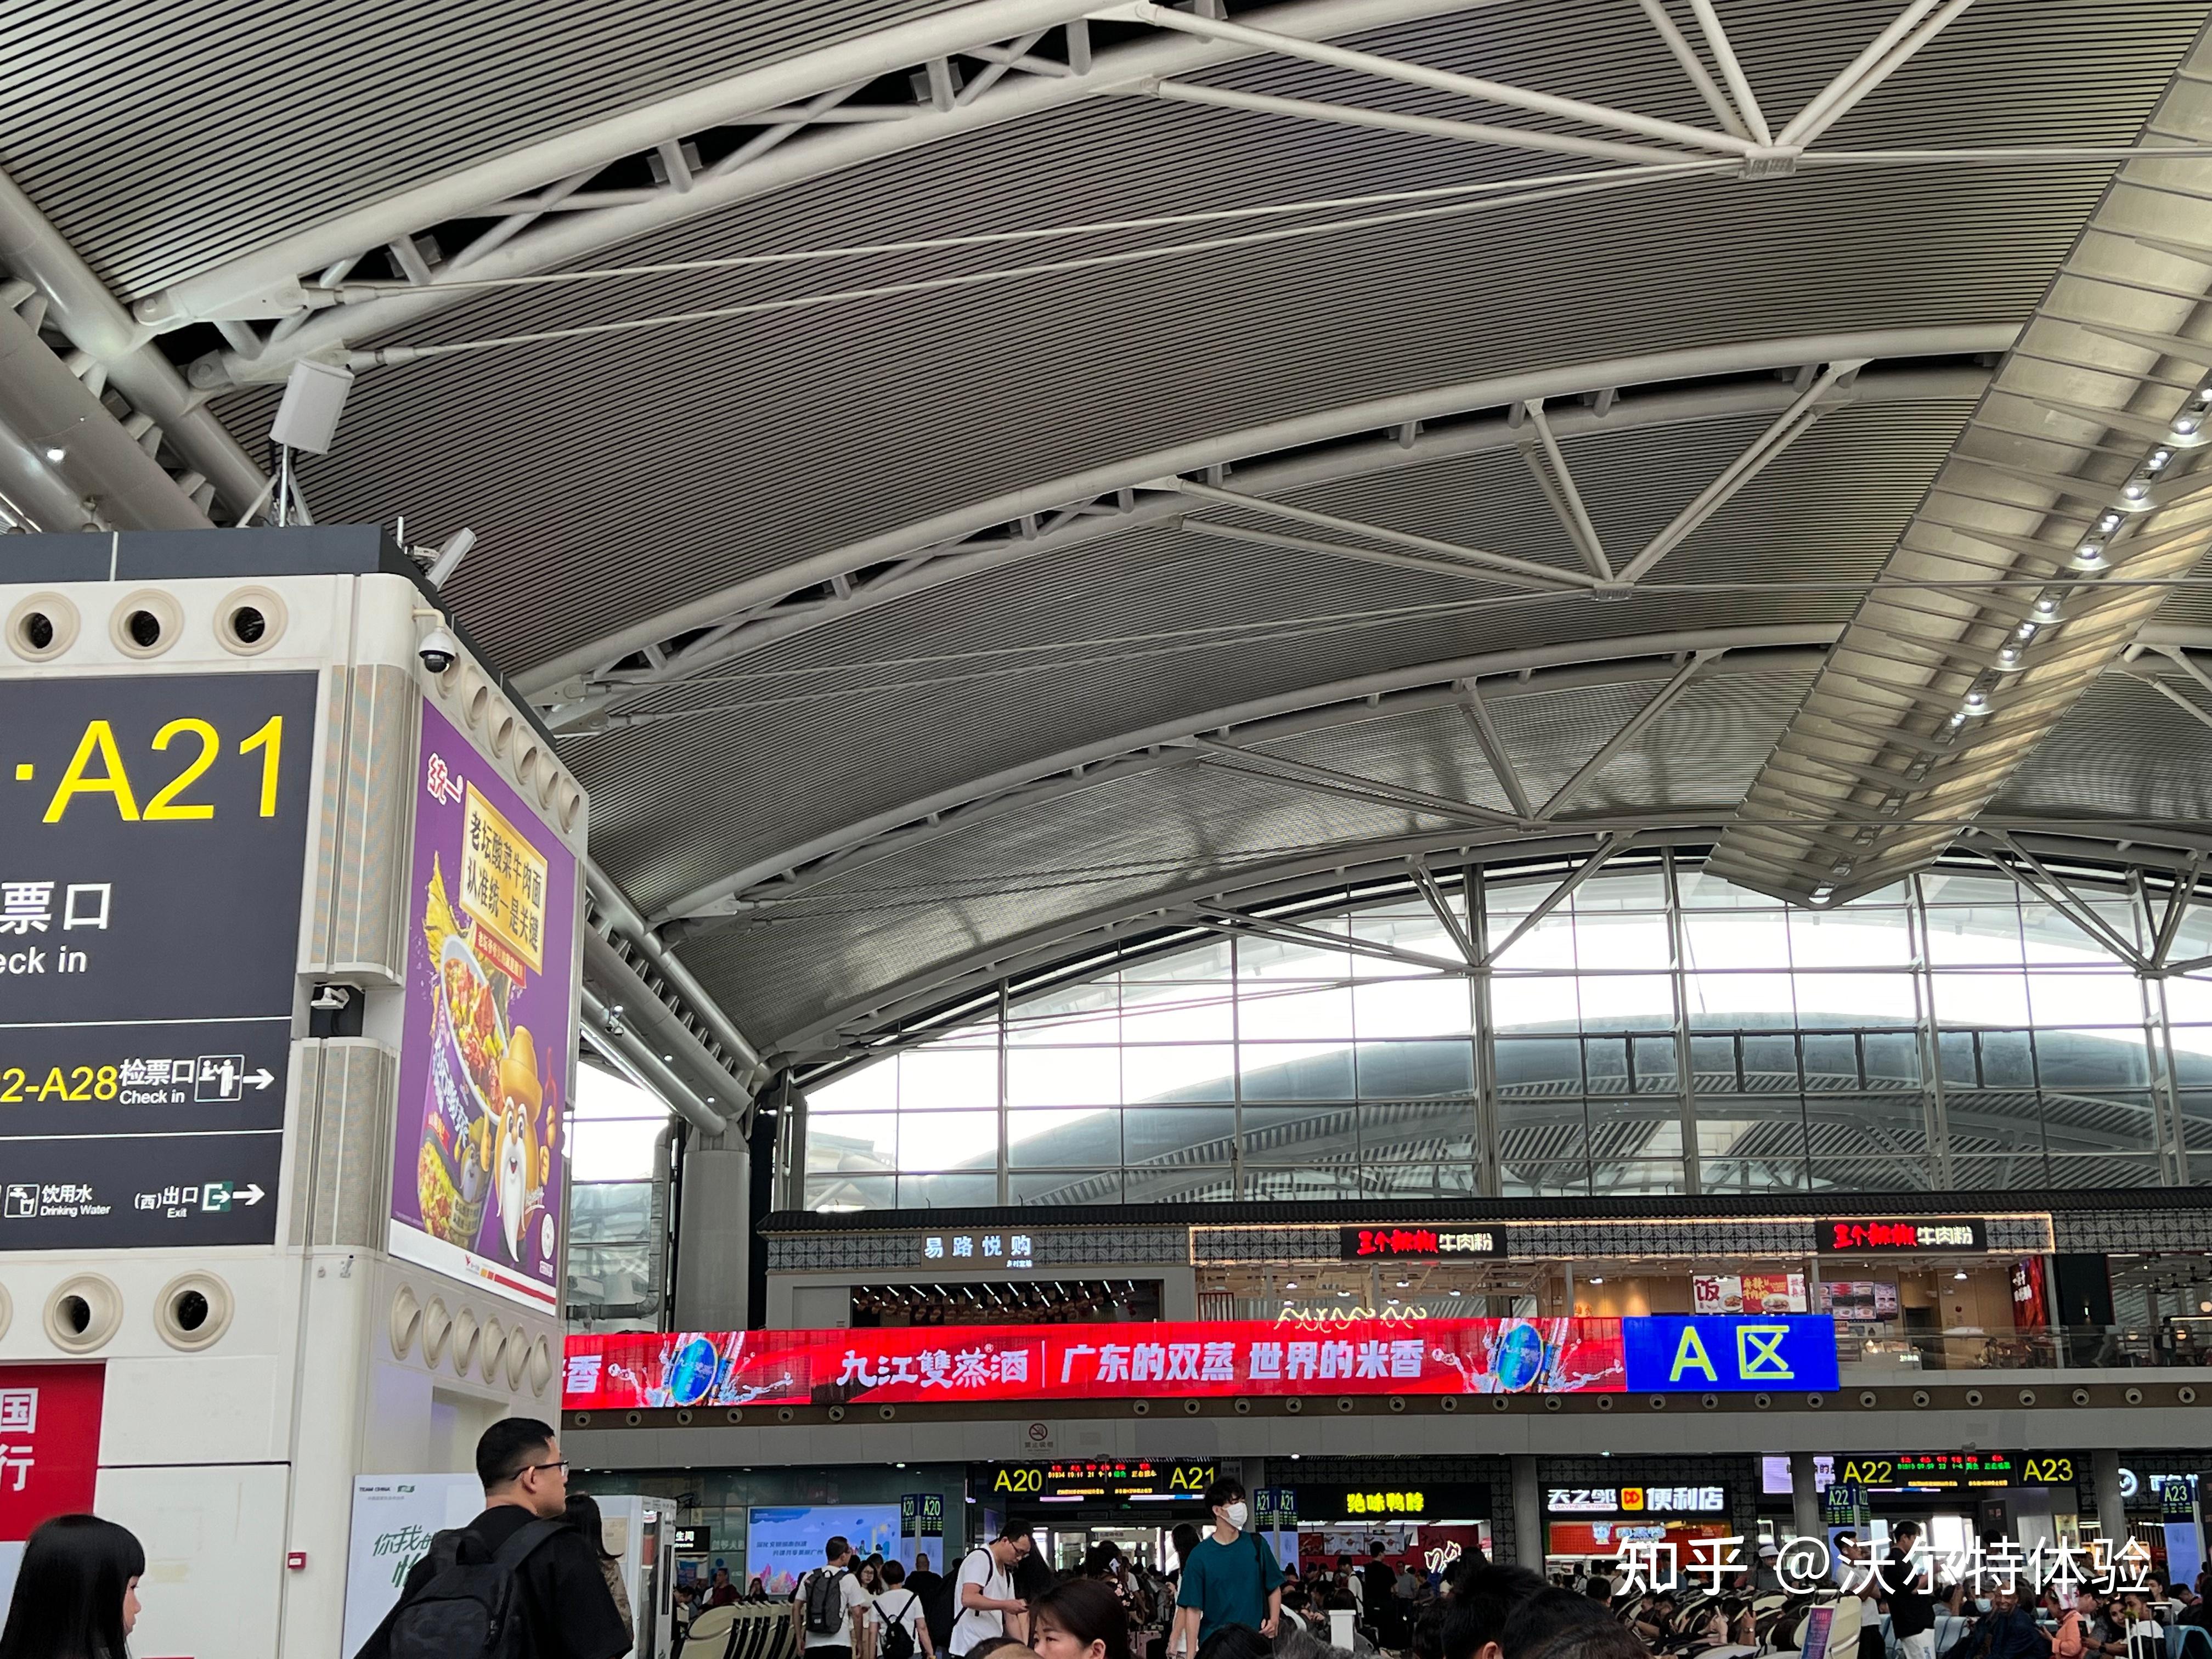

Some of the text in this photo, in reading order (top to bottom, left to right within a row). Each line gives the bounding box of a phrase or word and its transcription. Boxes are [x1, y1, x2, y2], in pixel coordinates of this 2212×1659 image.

[469, 811, 542, 909] 老坛酸菜牛肉面
[0, 882, 111, 934] 票口
[467, 857, 539, 953] 认准统一是关键
[58, 945, 87, 973] in
[119, 1058, 194, 1086] 检票口
[120, 1090, 184, 1104] Check in
[42, 1184, 92, 1203] 饮用水
[40, 1204, 187, 1218] Drinking Water Exit
[924, 1235, 1031, 1258] 易路悦购
[1357, 1229, 1493, 1255] 三个牛肉粉
[1833, 1222, 1973, 1249] 三个牛肉粉
[1060, 1341, 1235, 1383] 广东的双蒸
[1249, 1339, 1424, 1380] 世界的米香
[1669, 1325, 1795, 1381] A 区
[562, 1354, 602, 1393] 香
[0, 1387, 38, 1434] 国
[0, 1443, 35, 1491] 行
[1170, 1467, 1214, 1489] A21
[1843, 1461, 1893, 1484] A22
[2023, 1459, 2073, 1482] A23
[995, 1469, 1042, 1492] A20
[1257, 1495, 1269, 1511] A21
[1280, 1494, 1294, 1510] A21
[1347, 1492, 1424, 1513] 绝味鸭脖
[1548, 1487, 1724, 1511] 天之邻 便利店
[1829, 1489, 1849, 1505] A22
[2165, 1486, 2188, 1502] A23
[903, 1500, 914, 1516] A20
[924, 1500, 941, 1516] A20
